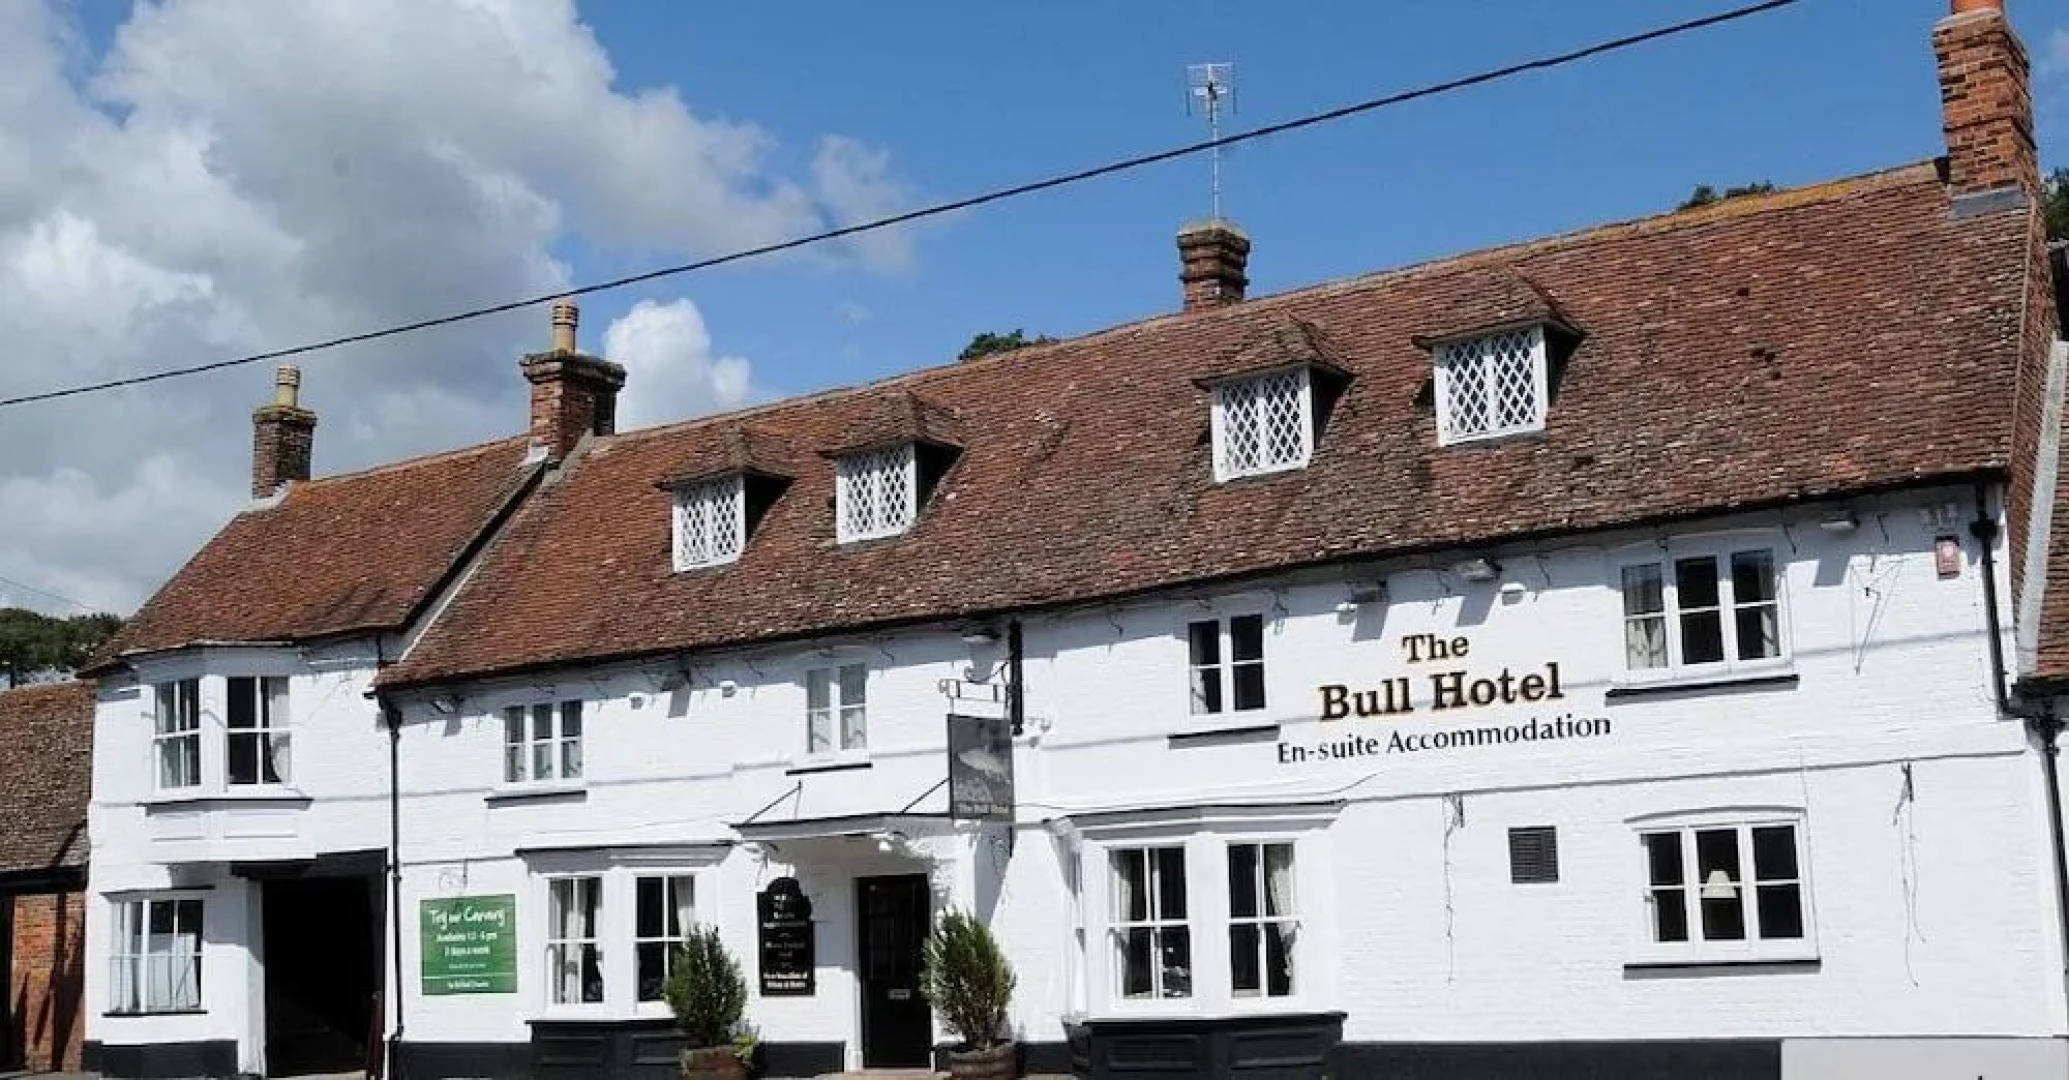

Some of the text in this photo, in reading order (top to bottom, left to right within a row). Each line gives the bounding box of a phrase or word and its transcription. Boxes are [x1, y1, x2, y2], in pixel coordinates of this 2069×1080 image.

[1402, 633, 1469, 663] The
[1319, 660, 1565, 721] Bull Hotel
[1277, 714, 1612, 764] En-suite Accommodation
[428, 909, 447, 931] Try
